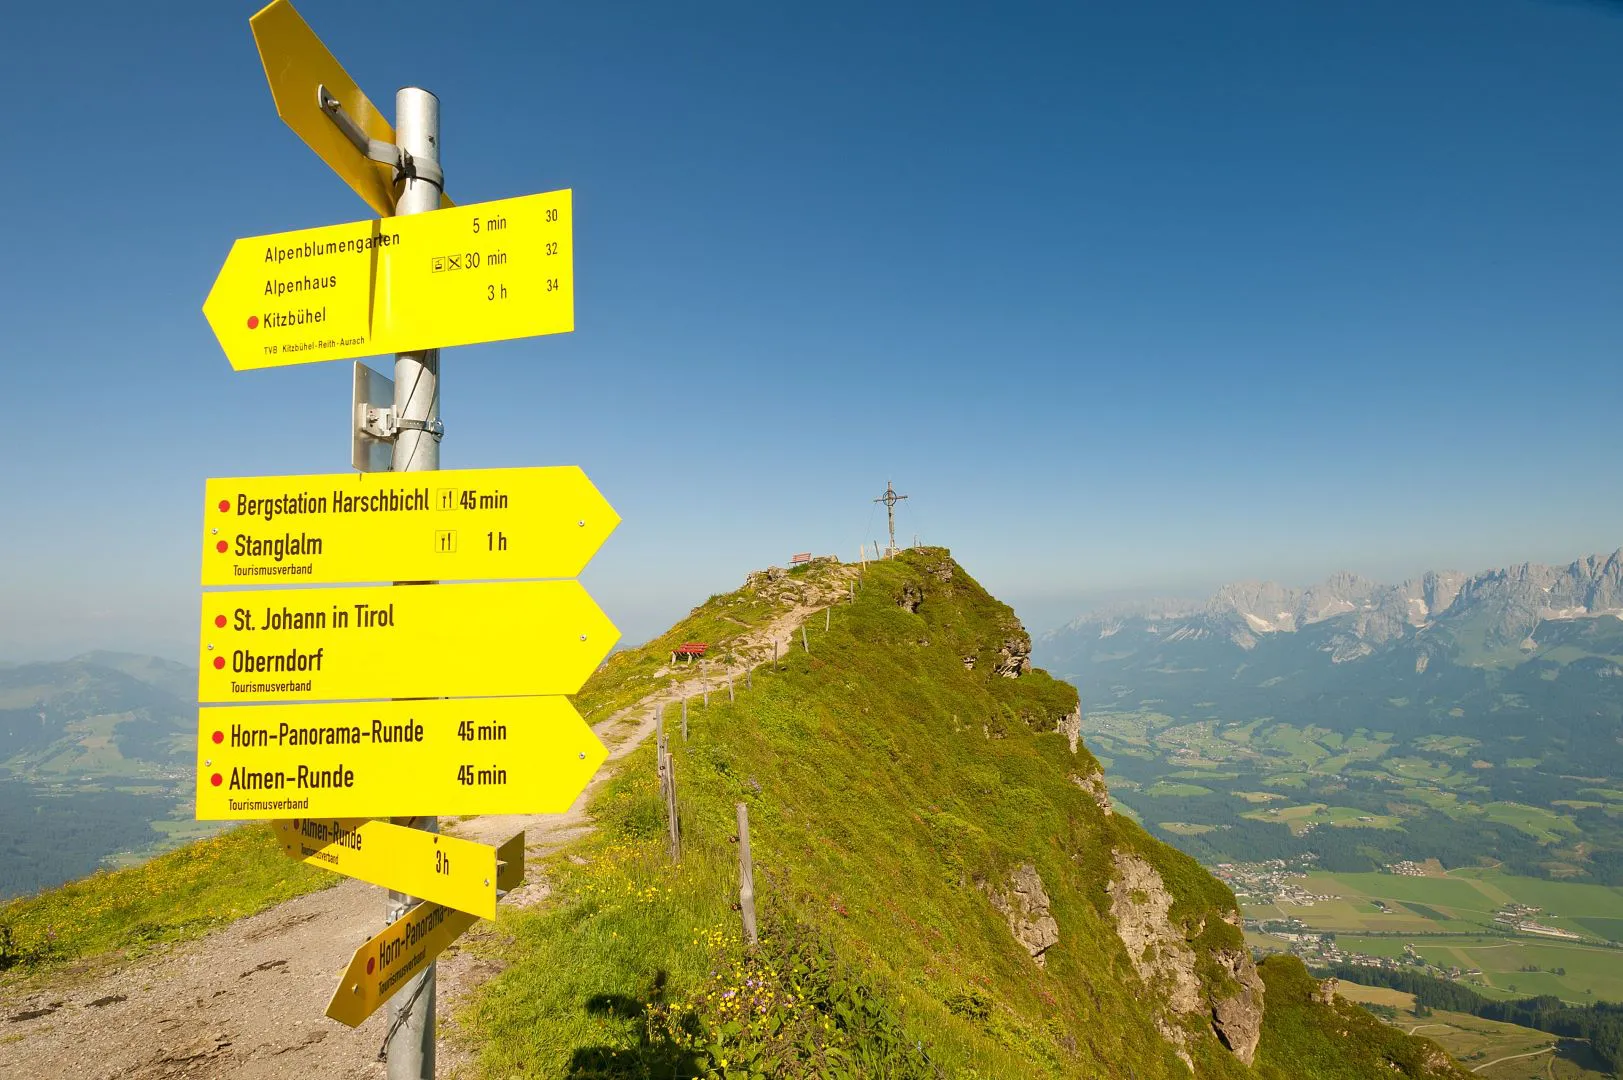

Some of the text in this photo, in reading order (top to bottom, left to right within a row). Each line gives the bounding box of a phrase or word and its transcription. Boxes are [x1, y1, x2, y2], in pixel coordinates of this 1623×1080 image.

[264, 208, 558, 264] Alpenblumengarten 5 min 30
[264, 242, 558, 297] Alpenhaus 30 min 32
[263, 278, 559, 329] Kitzbühel 3 h 34
[264, 345, 278, 355] TVB
[237, 487, 508, 522] Bergstation Harschbichl 45 min
[234, 531, 507, 562] Stanglalm 1 h
[233, 563, 313, 576] Tourismusverband
[233, 603, 395, 632] St. Johann in Tirol
[232, 647, 324, 674] Oberndorf
[231, 679, 312, 693] Tourismusverband
[231, 718, 507, 748] Horn-Panorama-Runde 45 min
[228, 763, 507, 791] Almen-Runde 45 min
[229, 797, 309, 811] Tourismusverband
[301, 819, 449, 876] Almen-Runde 3 h
